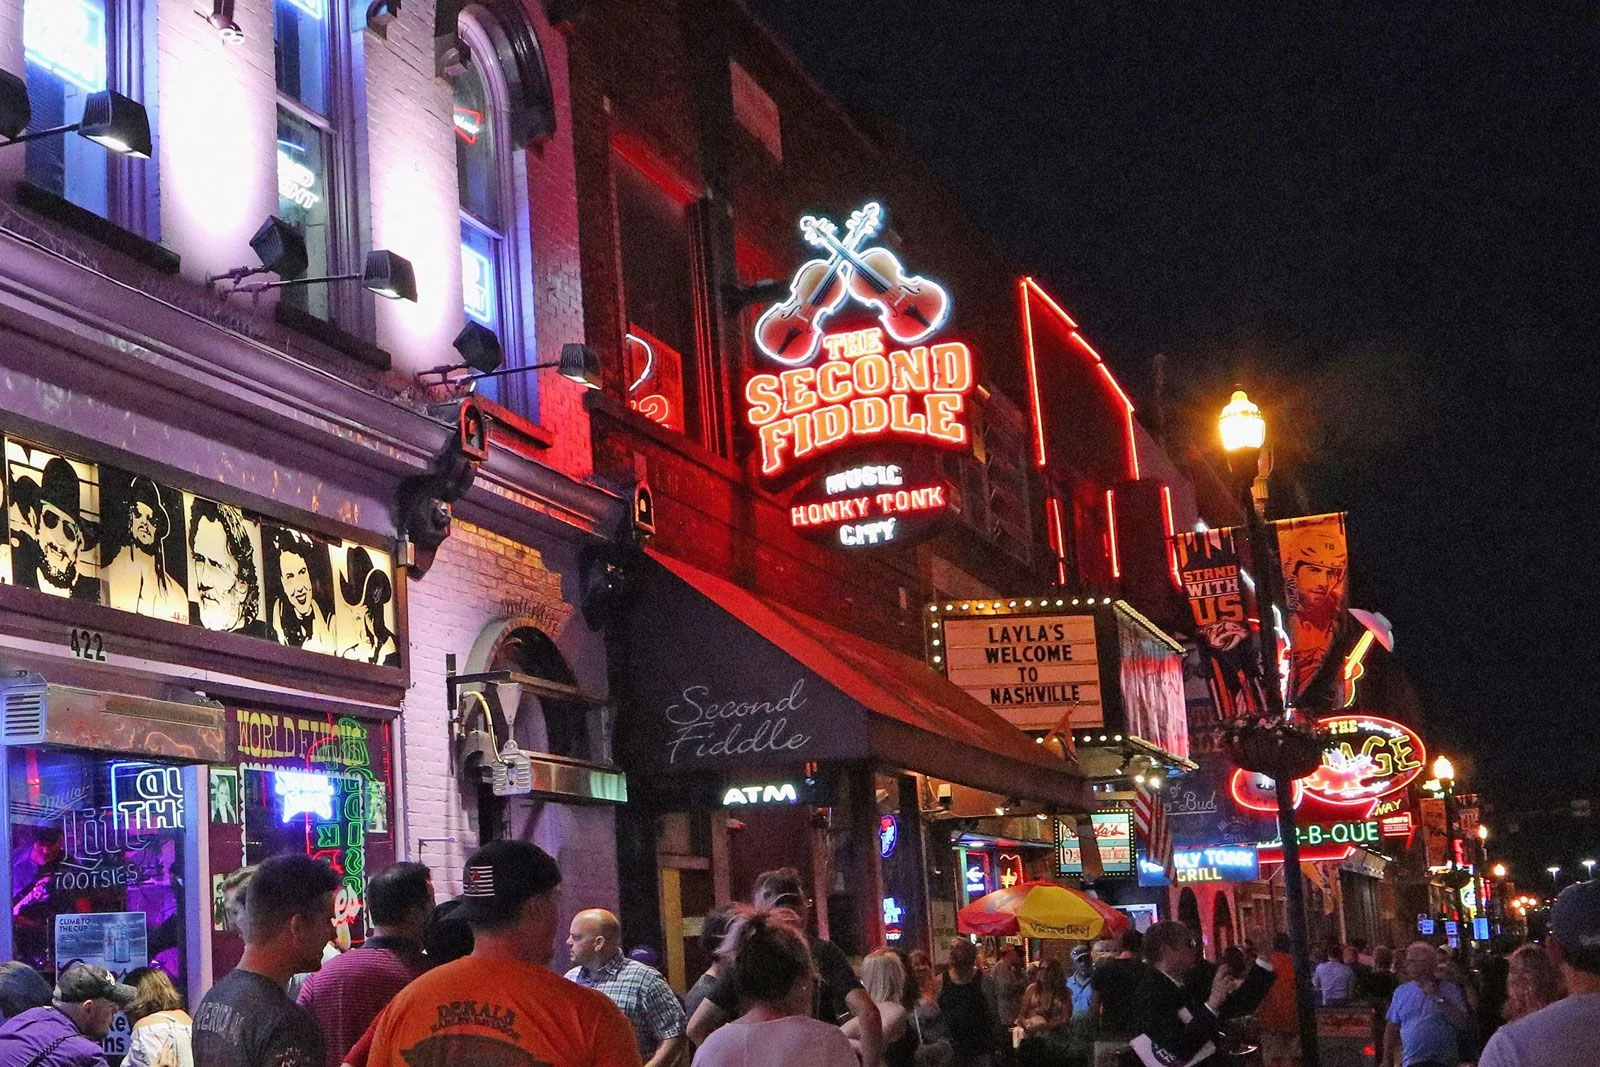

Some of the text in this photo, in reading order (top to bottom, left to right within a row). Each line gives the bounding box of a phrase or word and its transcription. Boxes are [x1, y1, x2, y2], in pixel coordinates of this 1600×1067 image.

[823, 327, 883, 360] THE
[746, 342, 972, 424] SECOND
[759, 393, 967, 474] FIDDLE
[825, 464, 902, 495] MUSIC
[791, 486, 945, 526] HONKY TONK
[839, 517, 897, 546] CITY
[1183, 564, 1237, 582] STAND
[1186, 578, 1240, 597] WITH
[1189, 593, 1243, 626] US
[70, 629, 106, 661] 422
[989, 624, 1065, 643] LAYLA'S
[985, 644, 1073, 664] WELCOME
[1017, 667, 1038, 683] TO
[666, 679, 808, 724] Second
[991, 685, 1080, 704] NASHVILLE
[237, 710, 295, 758] WORLD
[1328, 720, 1358, 734] THE
[665, 718, 812, 764] Fiddle
[722, 784, 797, 806] ATM
[1205, 849, 1254, 866] TONK
[55, 864, 138, 889] TOOTSIES
[1177, 867, 1222, 882] GRILL
[59, 917, 91, 926] CLIMB TO
[59, 924, 89, 933] THE CUP
